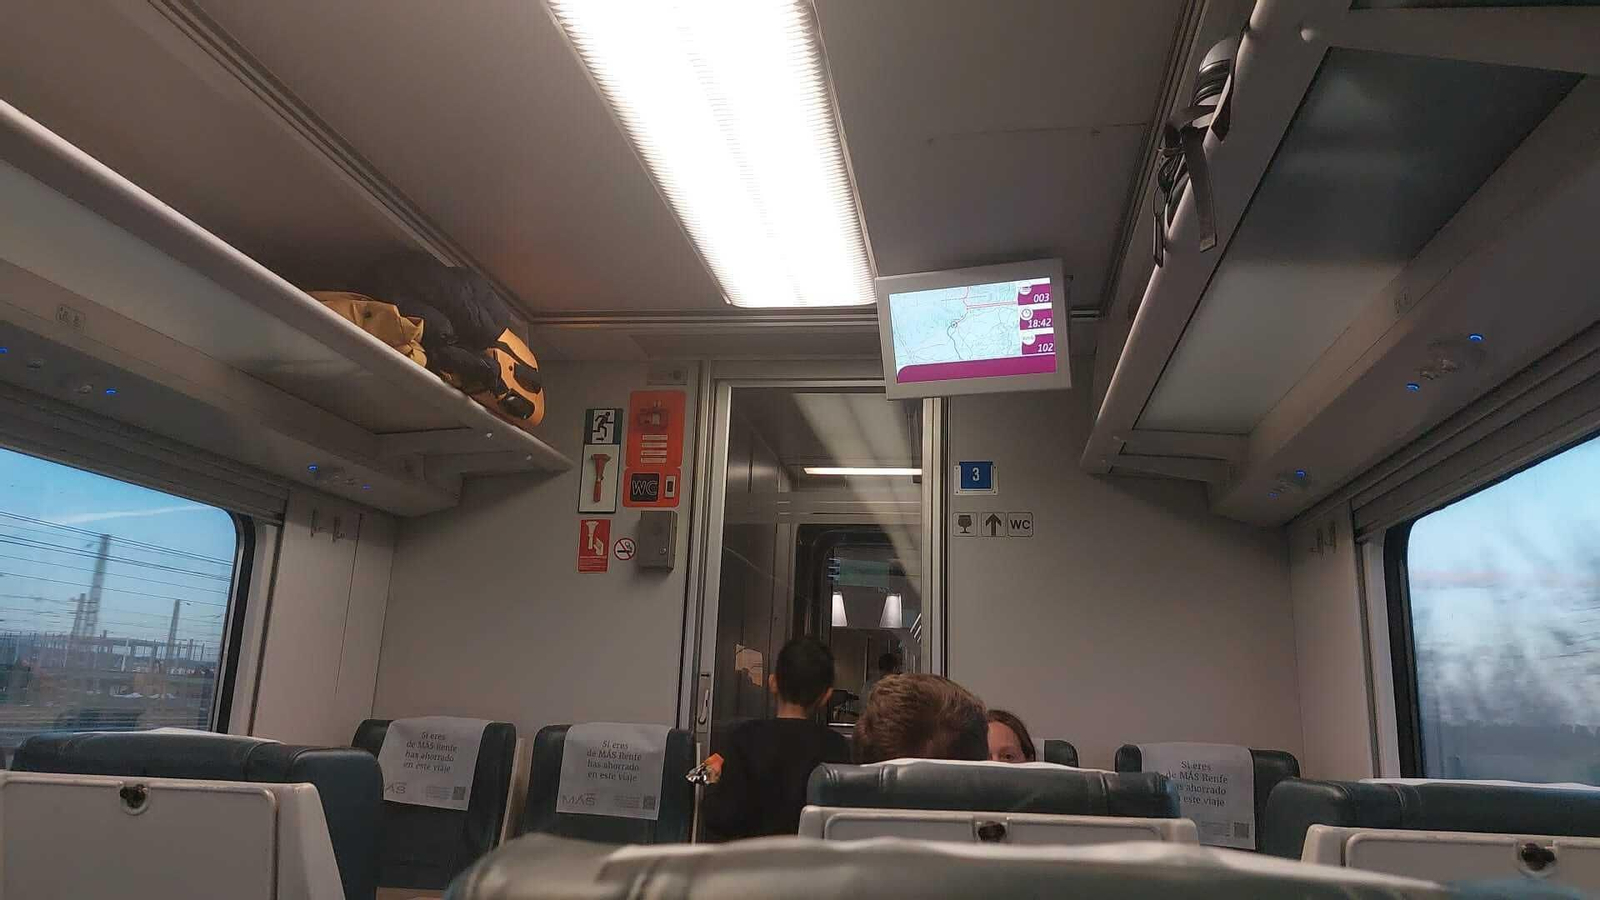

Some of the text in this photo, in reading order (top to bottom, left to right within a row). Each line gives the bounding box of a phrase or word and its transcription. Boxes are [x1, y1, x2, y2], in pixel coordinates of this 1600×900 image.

[1033, 292, 1050, 303] 003
[1027, 317, 1052, 328] 18:42
[1037, 342, 1054, 353] 102
[972, 467, 980, 482] 3
[631, 479, 658, 496] WC
[1009, 519, 1031, 530] WC
[611, 742, 629, 750] eres
[586, 749, 597, 757] de
[603, 761, 640, 771] ahorrado
[1193, 763, 1212, 771] eres
[1202, 773, 1228, 784] Renfe
[1186, 783, 1227, 795] ahorrado
[1203, 797, 1225, 807] viaje
